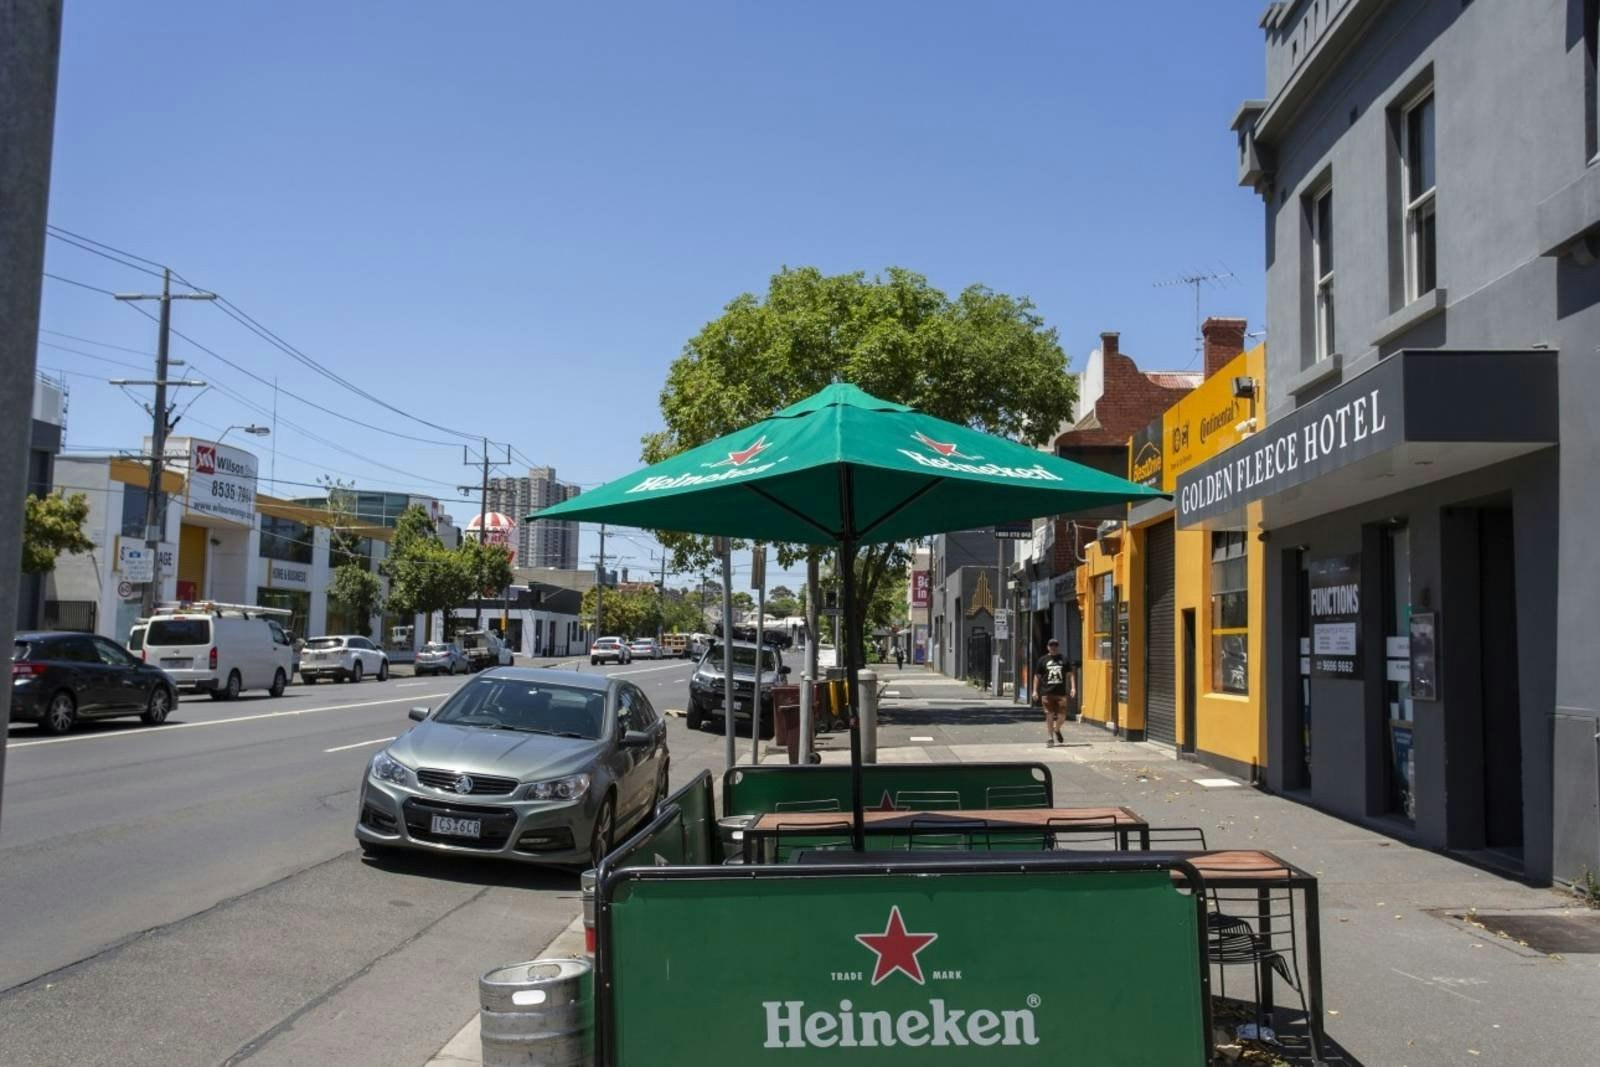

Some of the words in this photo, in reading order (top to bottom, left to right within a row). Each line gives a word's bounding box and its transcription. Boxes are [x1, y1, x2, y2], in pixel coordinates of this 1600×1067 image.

[1181, 463, 1234, 514] GOLDEN
[1236, 432, 1299, 492] FLEECE
[1304, 389, 1386, 464] HOTEL
[217, 456, 243, 474] Wilson
[211, 480, 236, 500] 8535
[1311, 584, 1359, 616] FUNCTIONS
[831, 972, 863, 981] TRADE
[932, 970, 963, 980] MARK
